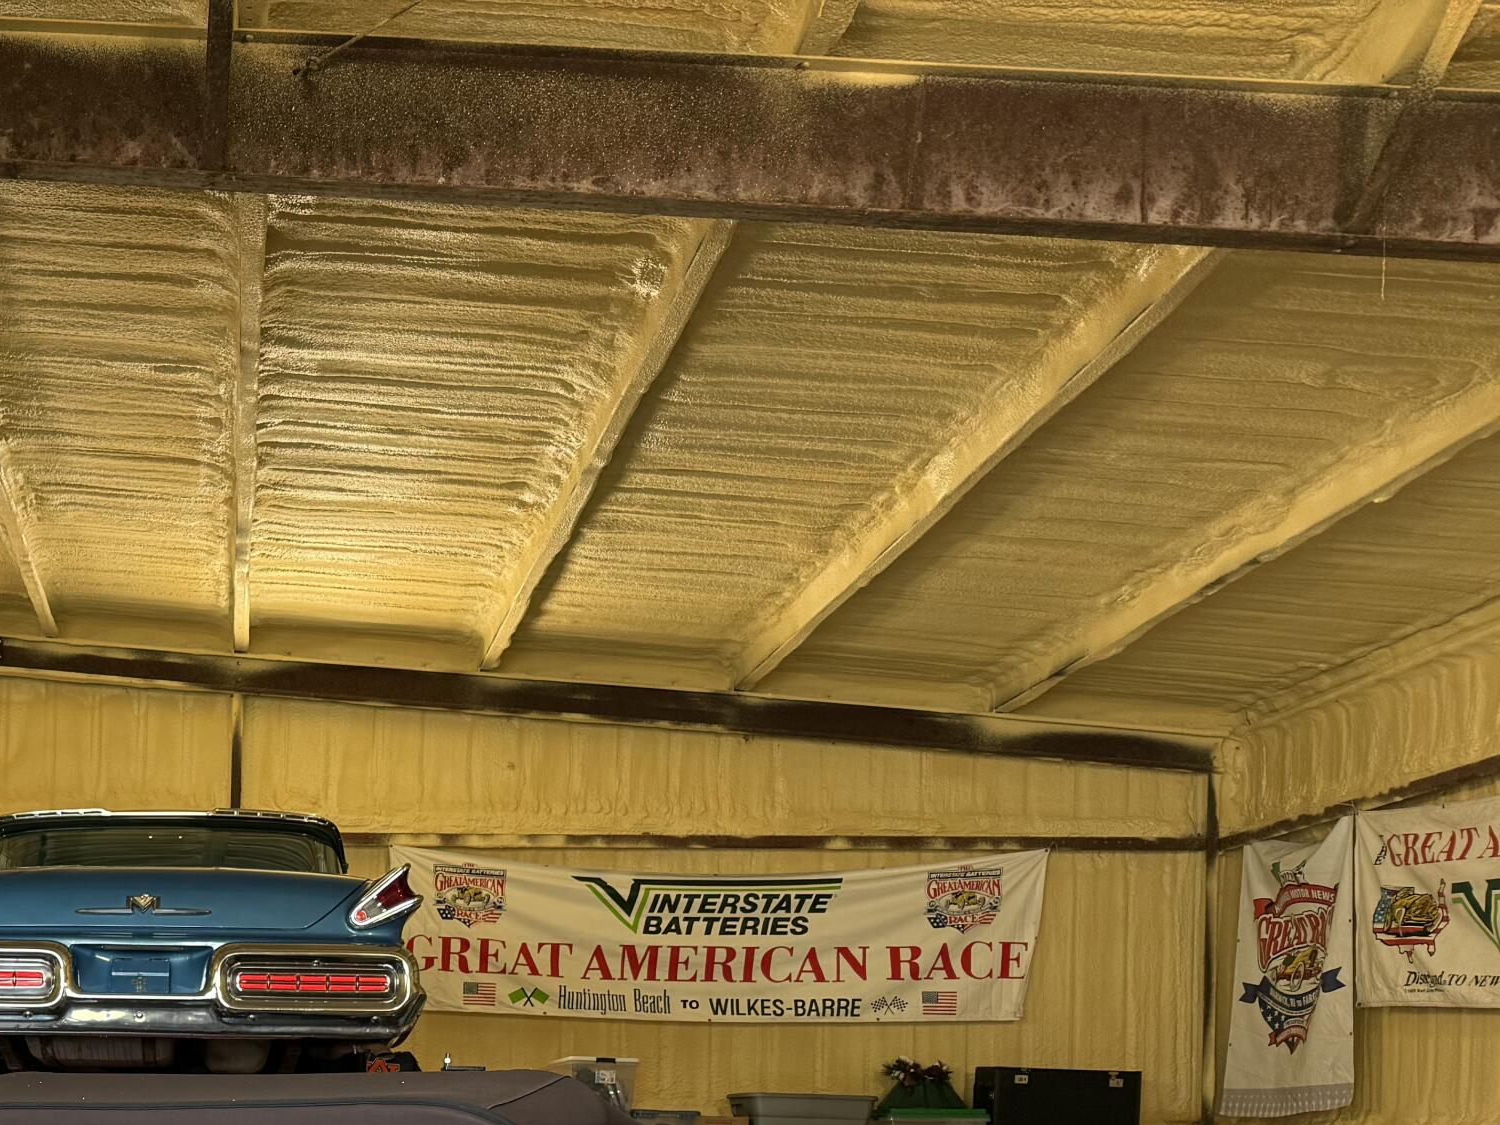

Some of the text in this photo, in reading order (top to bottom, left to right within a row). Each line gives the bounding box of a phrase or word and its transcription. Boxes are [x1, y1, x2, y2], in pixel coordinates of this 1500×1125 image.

[1386, 827, 1480, 867] GREAT
[648, 893, 833, 914] INTERSTATE
[1289, 888, 1335, 903] MOTOR NEWS
[456, 909, 481, 920] RACE
[948, 913, 979, 925] RACE
[643, 916, 809, 935] BATTERIES
[406, 934, 1029, 983] GREAT AMERICAN RACE
[1448, 974, 1468, 986] TO
[558, 984, 862, 1018] Huntington Beach TO WILKES-BARRE
